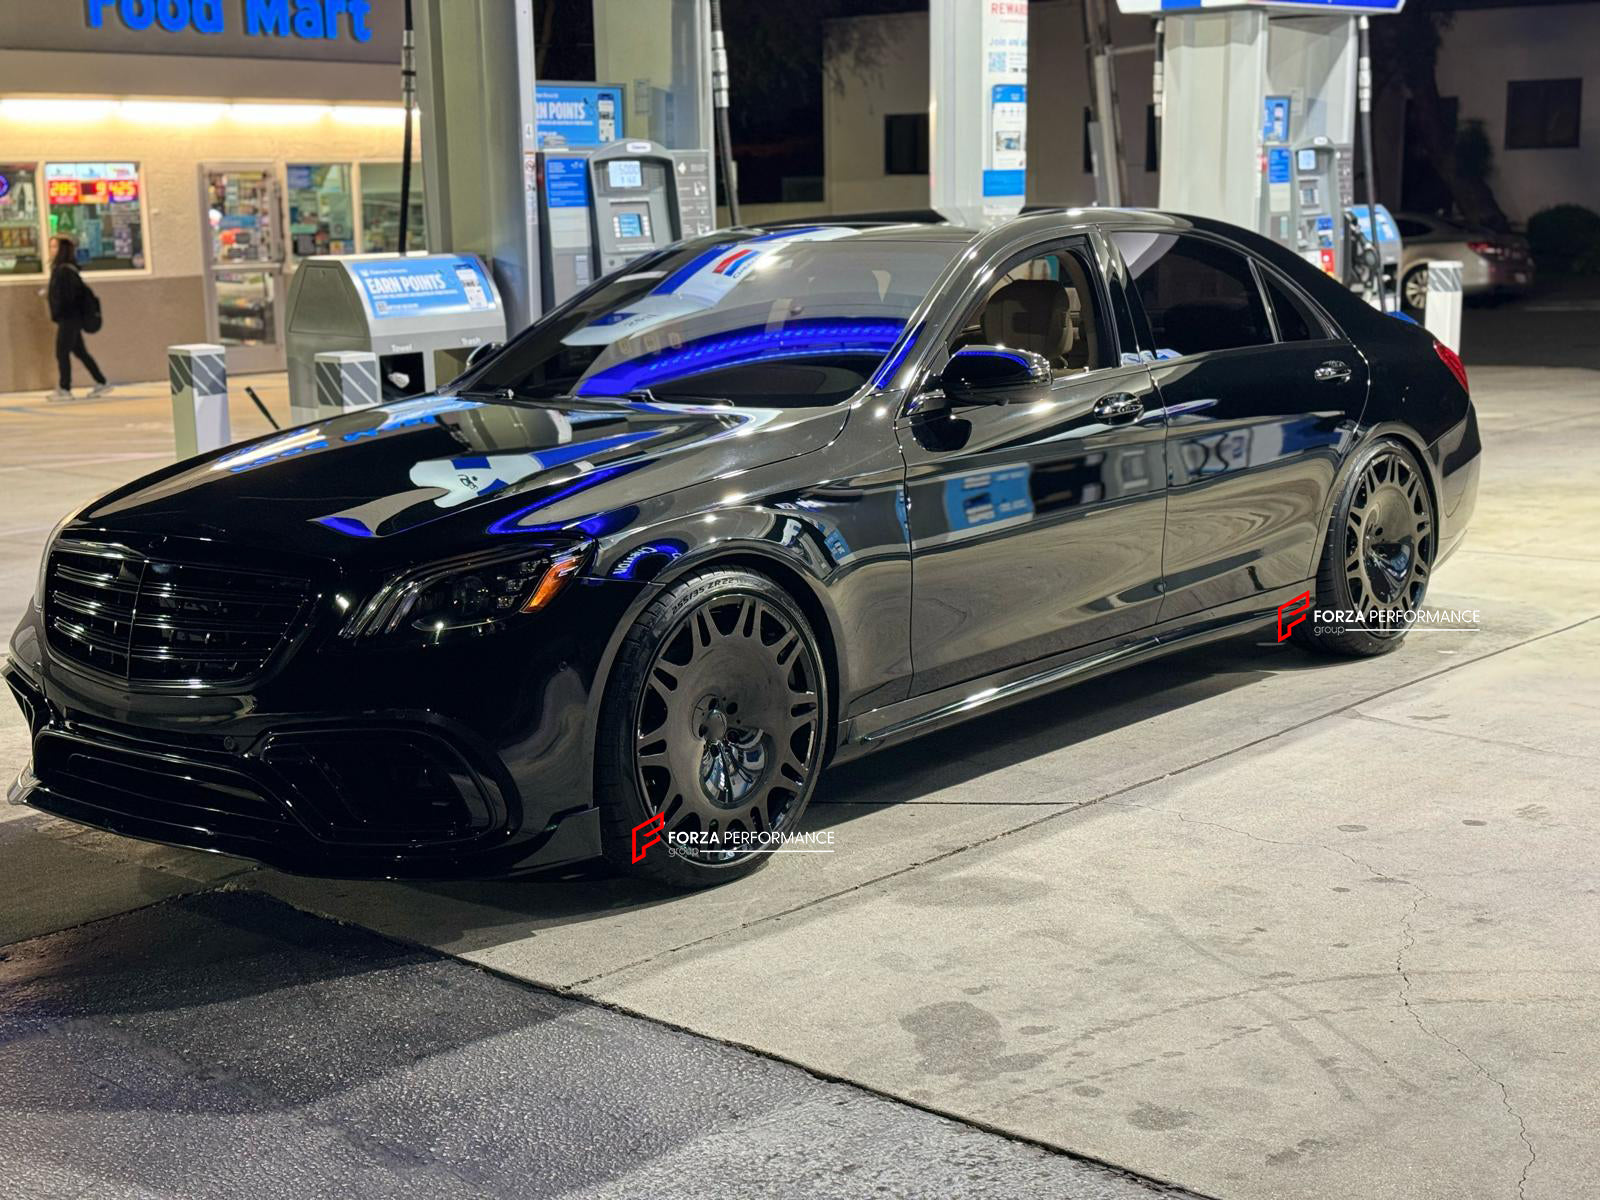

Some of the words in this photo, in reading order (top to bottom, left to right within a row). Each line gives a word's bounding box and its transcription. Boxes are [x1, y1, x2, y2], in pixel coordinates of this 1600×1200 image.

[245, 0, 371, 43] Mart
[549, 101, 586, 119] POINTS
[365, 277, 402, 294] EARN
[400, 274, 447, 291] POINTS
